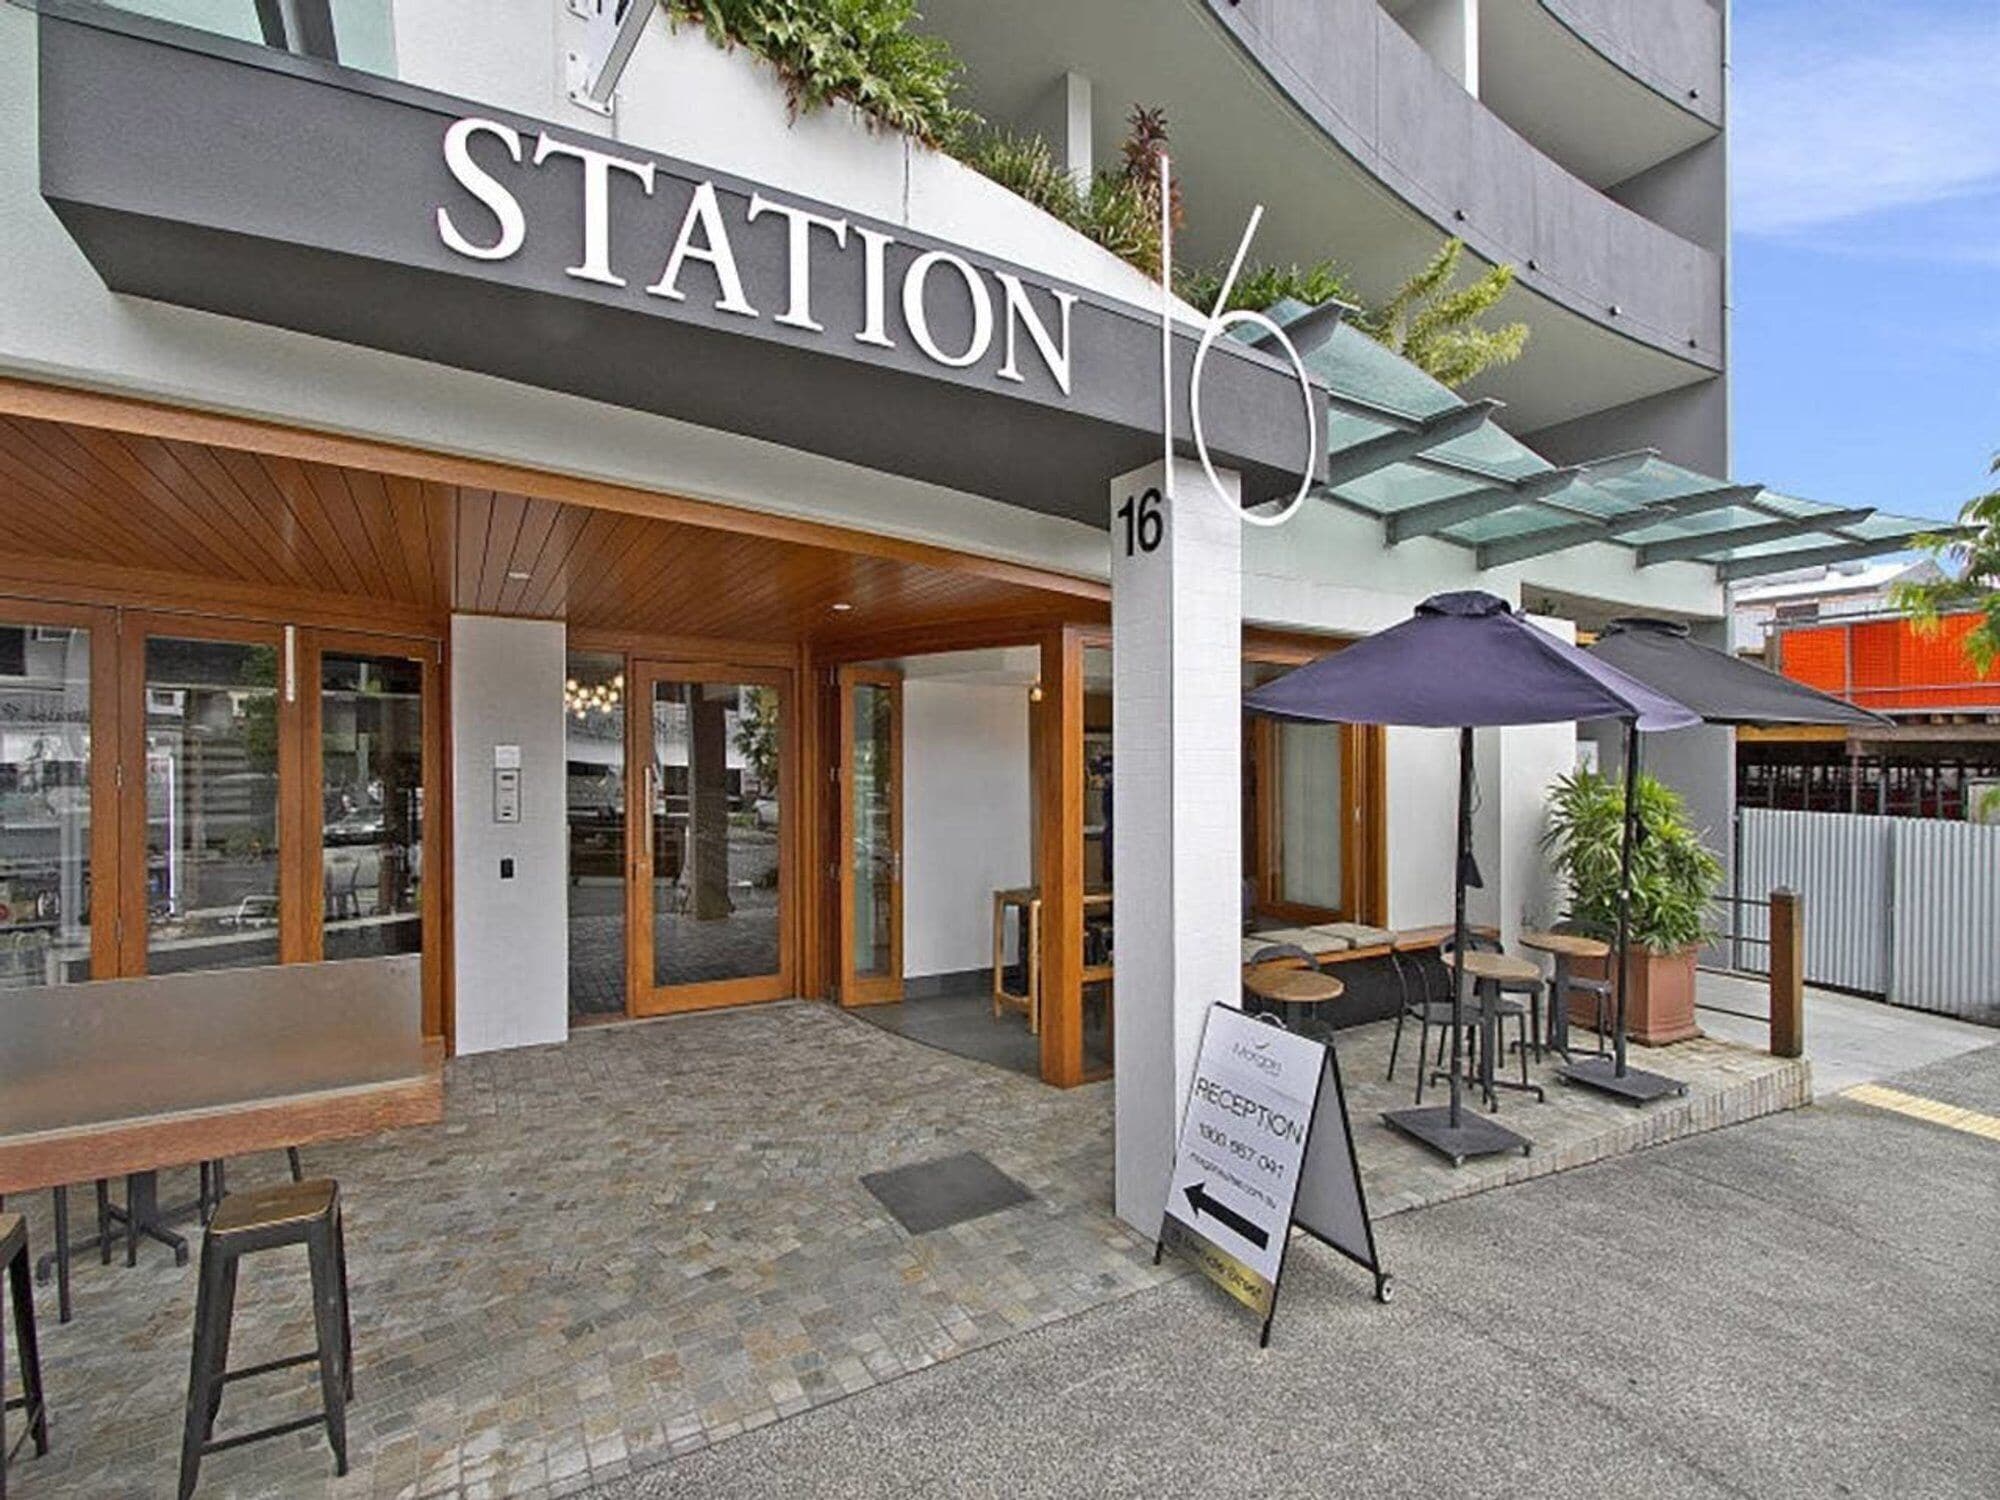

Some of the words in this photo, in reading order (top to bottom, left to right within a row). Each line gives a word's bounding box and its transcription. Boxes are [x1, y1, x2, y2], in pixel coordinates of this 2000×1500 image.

[436, 117, 1079, 396] STATION
[1160, 153, 1317, 526] 16
[1117, 487, 1164, 557] 16
[1195, 1076, 1305, 1145] RECEPTION
